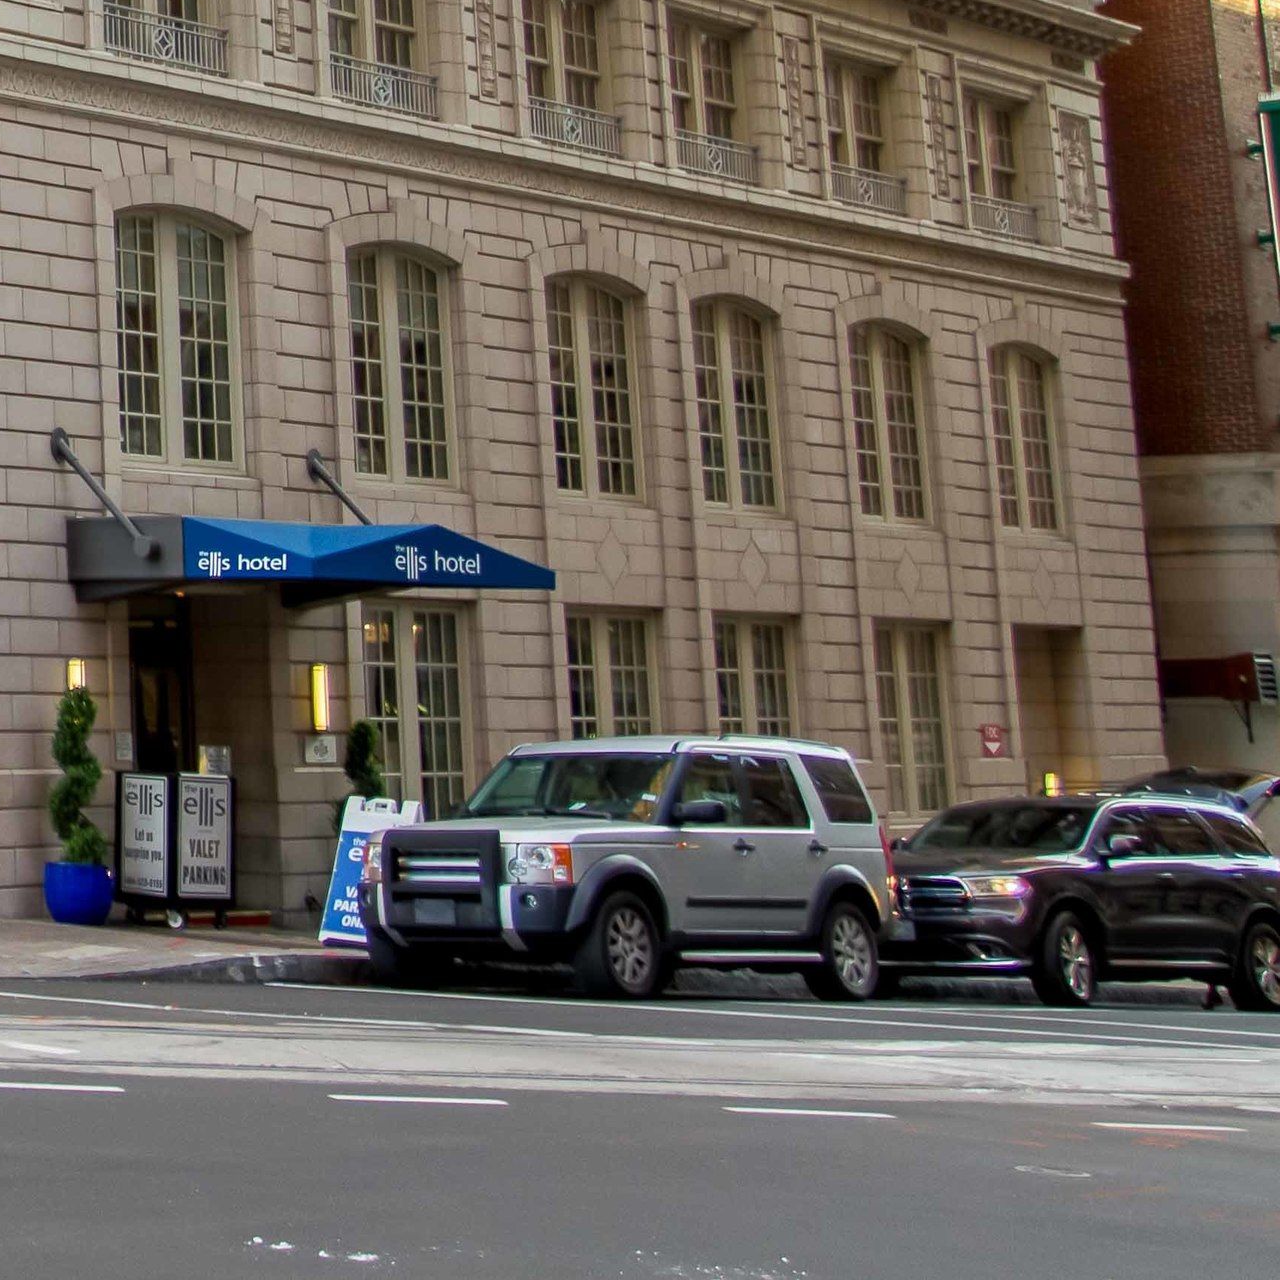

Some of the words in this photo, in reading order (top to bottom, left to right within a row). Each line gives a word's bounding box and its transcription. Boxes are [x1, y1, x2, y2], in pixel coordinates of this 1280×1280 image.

[198, 551, 231, 577] ellis
[238, 553, 287, 571] hotel
[395, 546, 428, 580] ellis
[434, 550, 480, 574] hotel
[126, 784, 164, 816] ellis
[183, 787, 226, 827] ellis
[189, 838, 221, 859] VALET
[182, 865, 226, 886] PARKING
[341, 915, 365, 930] ON
